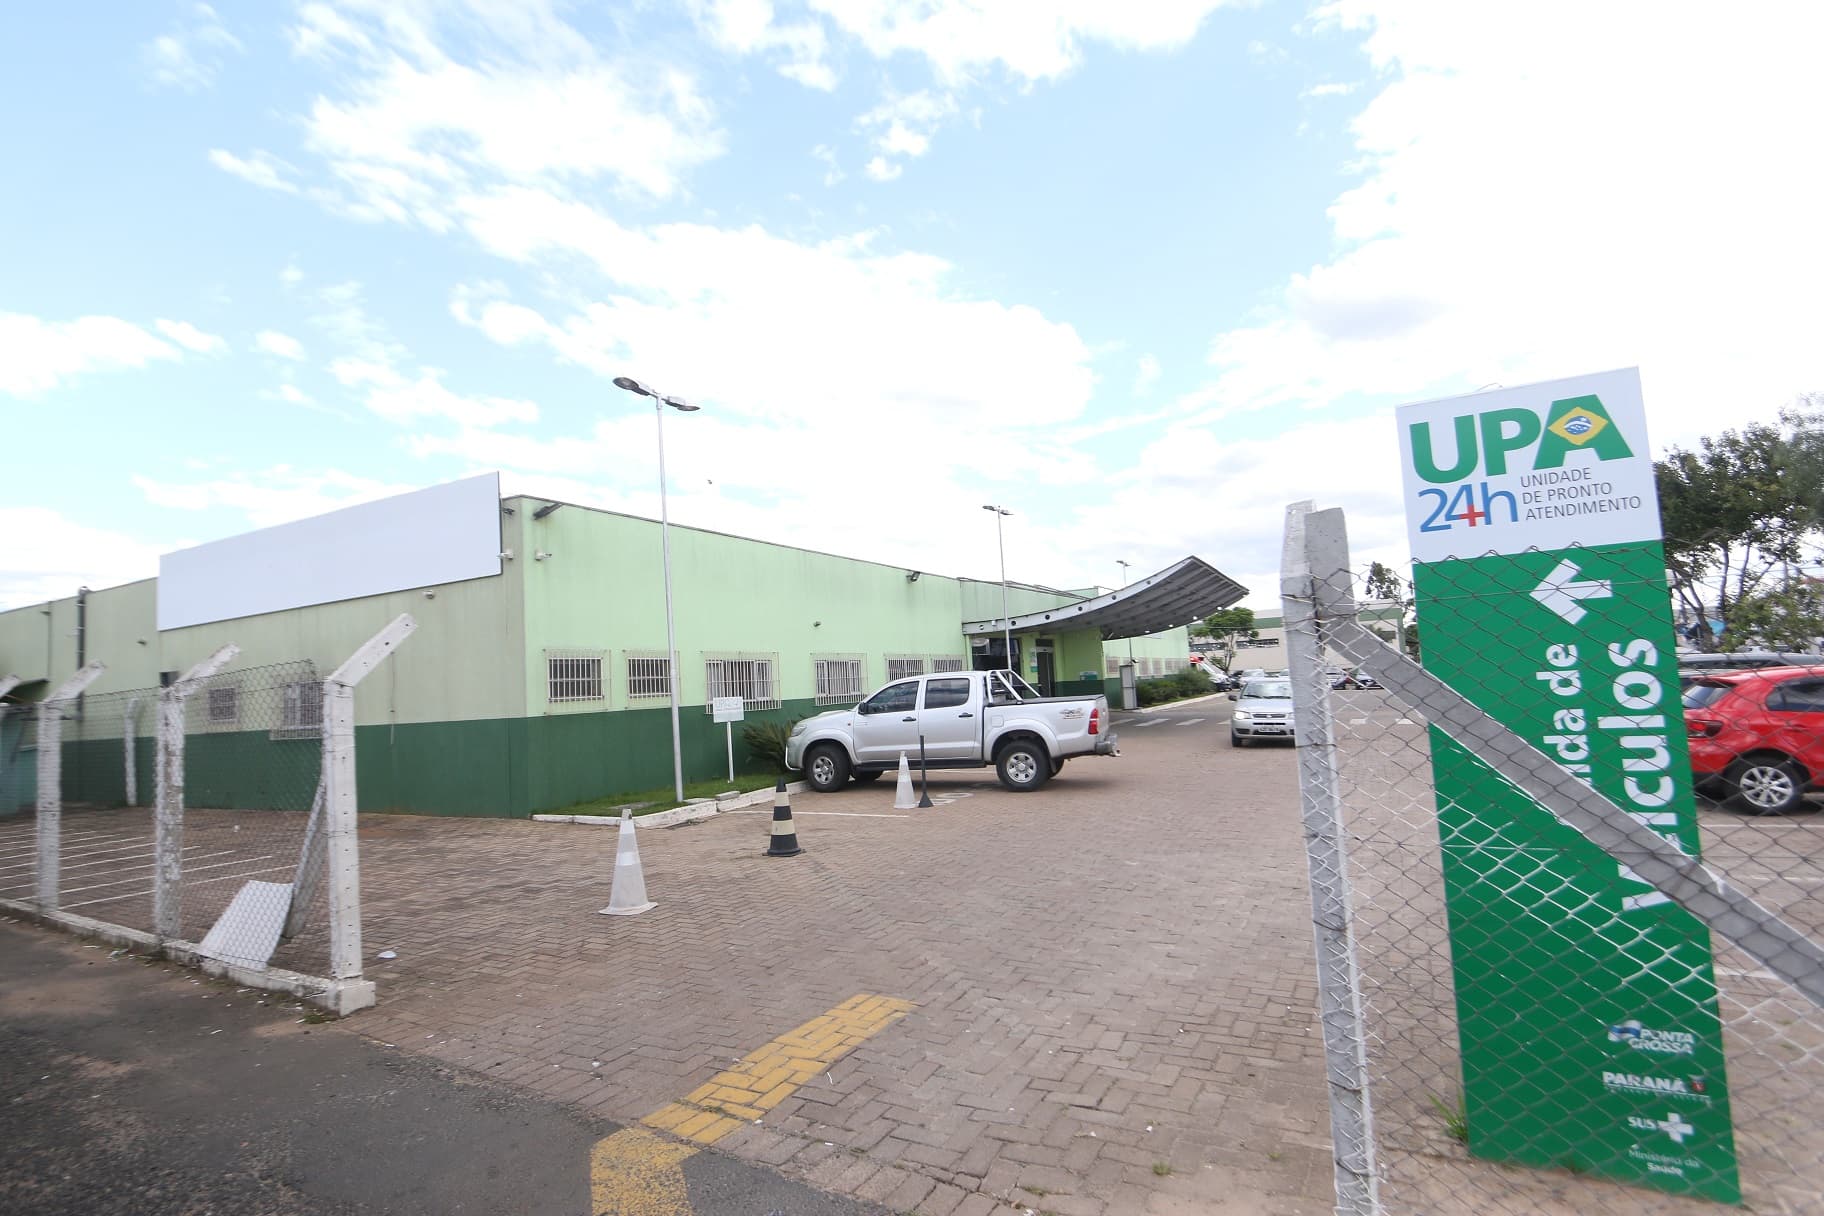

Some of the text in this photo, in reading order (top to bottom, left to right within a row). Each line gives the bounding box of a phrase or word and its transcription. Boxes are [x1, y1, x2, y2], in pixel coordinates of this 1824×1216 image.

[1409, 394, 1635, 484] UPA
[1520, 467, 1592, 488] UNIDADE
[1522, 481, 1613, 505] DE PRONTO
[1418, 482, 1519, 533] 24h
[1525, 495, 1642, 521] ATENDIMENTO
[1536, 643, 1582, 696] de
[1628, 1039, 1694, 1055] GROSSA
[1639, 1028, 1695, 1044] PONTA
[1627, 1116, 1657, 1130] SUS
